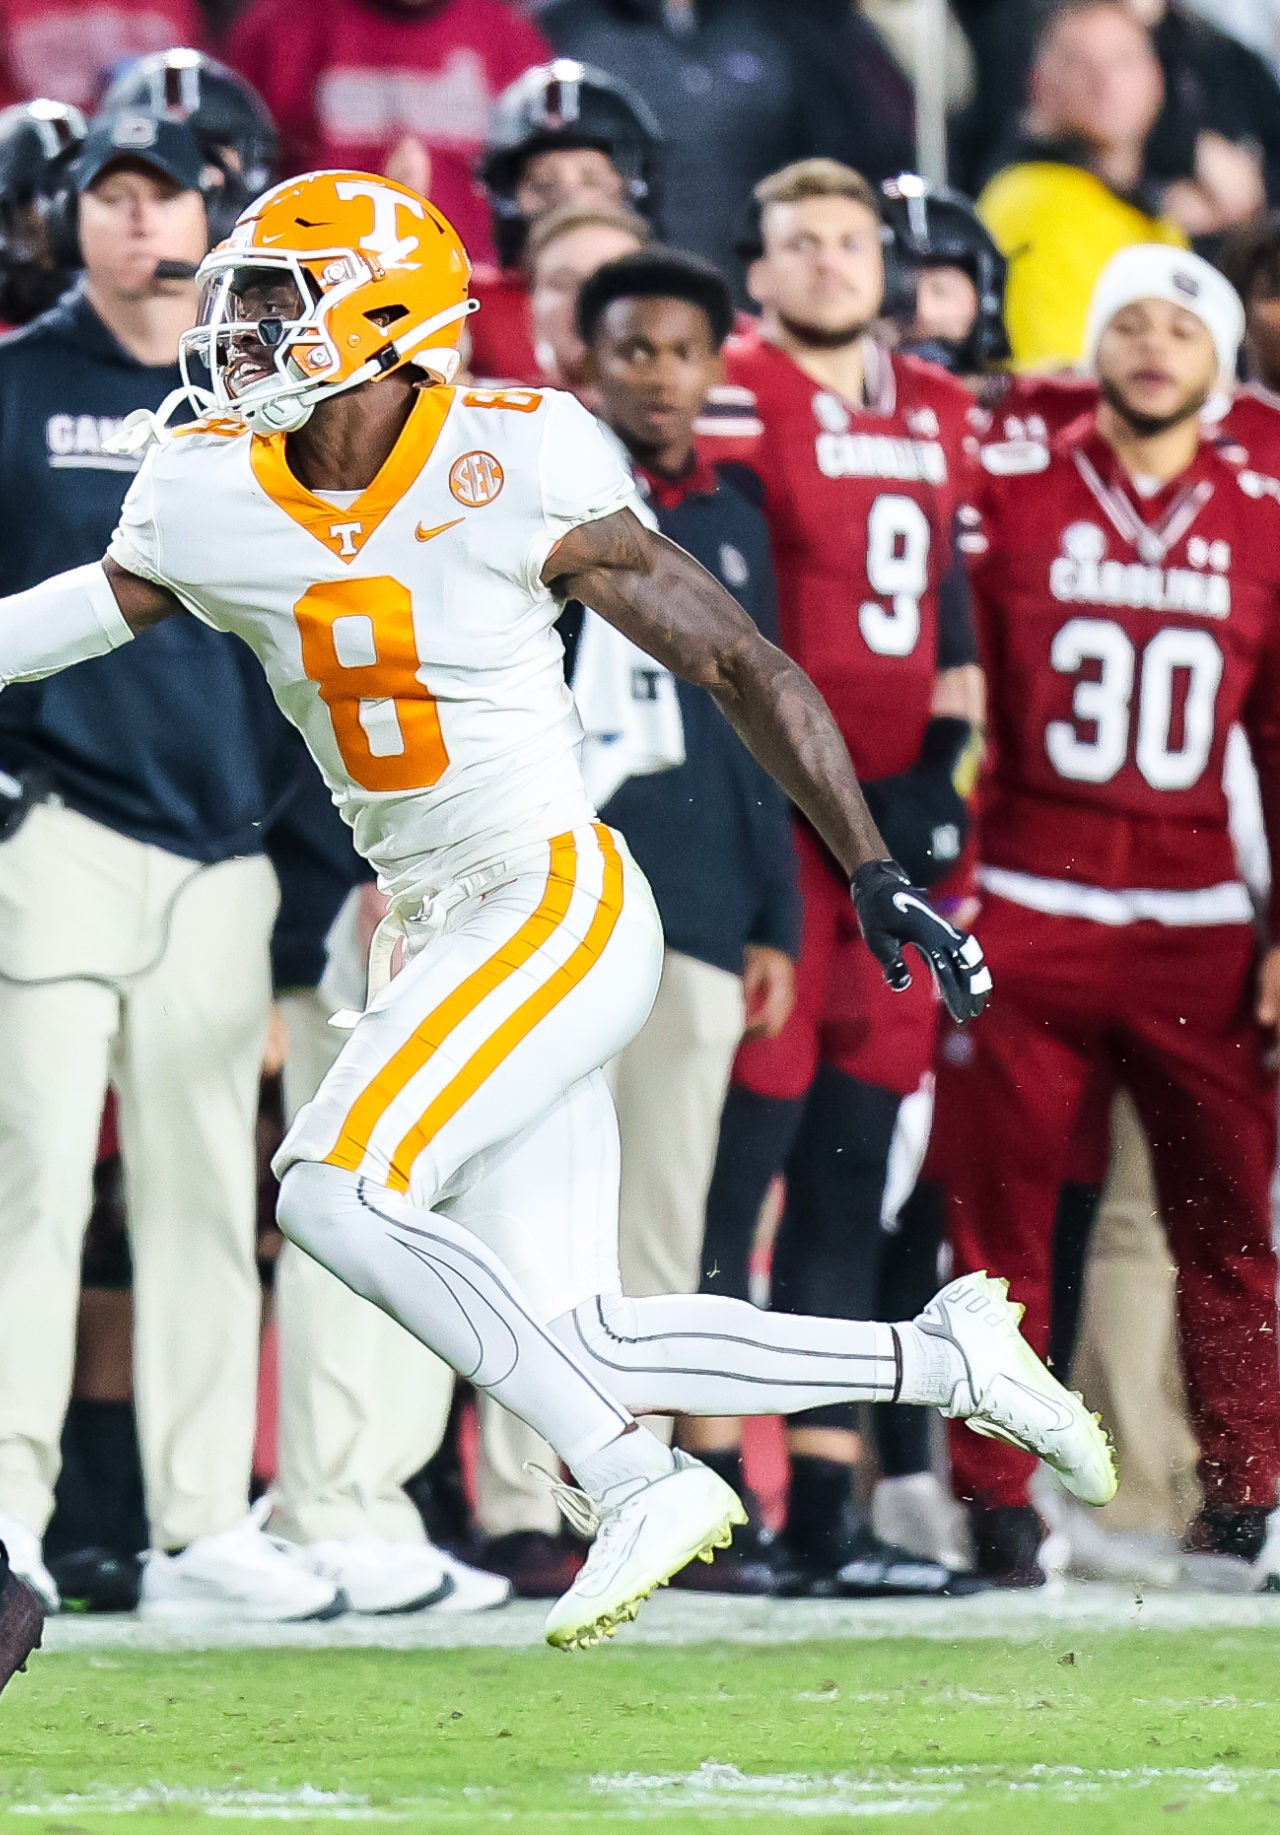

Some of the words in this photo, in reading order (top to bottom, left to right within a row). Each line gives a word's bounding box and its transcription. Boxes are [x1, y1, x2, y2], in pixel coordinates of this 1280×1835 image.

[334, 181, 425, 270] T
[328, 523, 362, 556] T
[453, 454, 502, 503] SEC
[858, 494, 930, 657] 9
[293, 574, 451, 792] 8
[1044, 617, 1224, 791] 30
